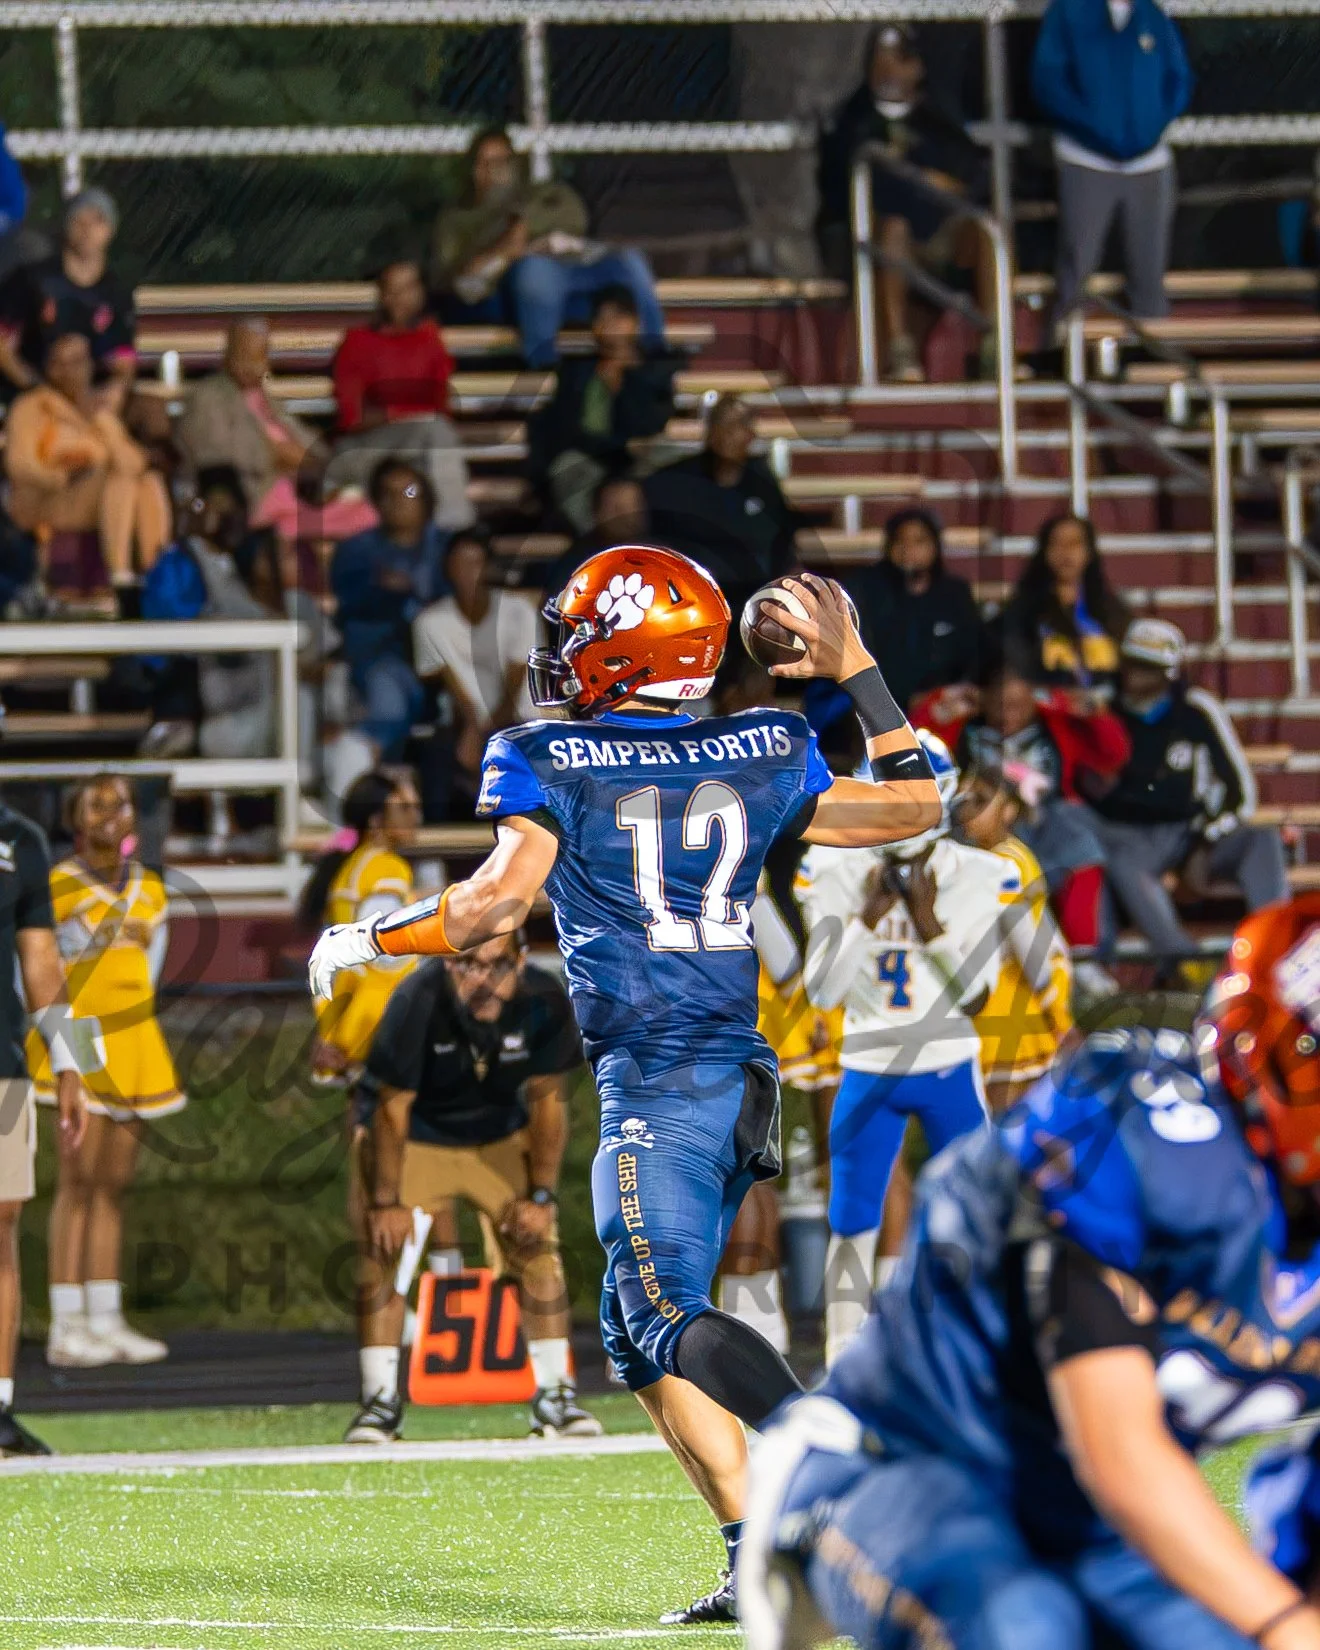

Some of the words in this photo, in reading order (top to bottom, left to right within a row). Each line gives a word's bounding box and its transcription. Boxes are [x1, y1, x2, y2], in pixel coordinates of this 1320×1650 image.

[548, 737, 681, 771] SEMPER
[681, 724, 793, 764] FORTIS
[614, 780, 754, 953] 12
[875, 949, 913, 1010] 4
[616, 1151, 638, 1193] SHIP
[619, 1194, 645, 1233] THE
[630, 1234, 652, 1261] UP
[638, 1261, 661, 1299] GIVE
[425, 1275, 525, 1375] 50
